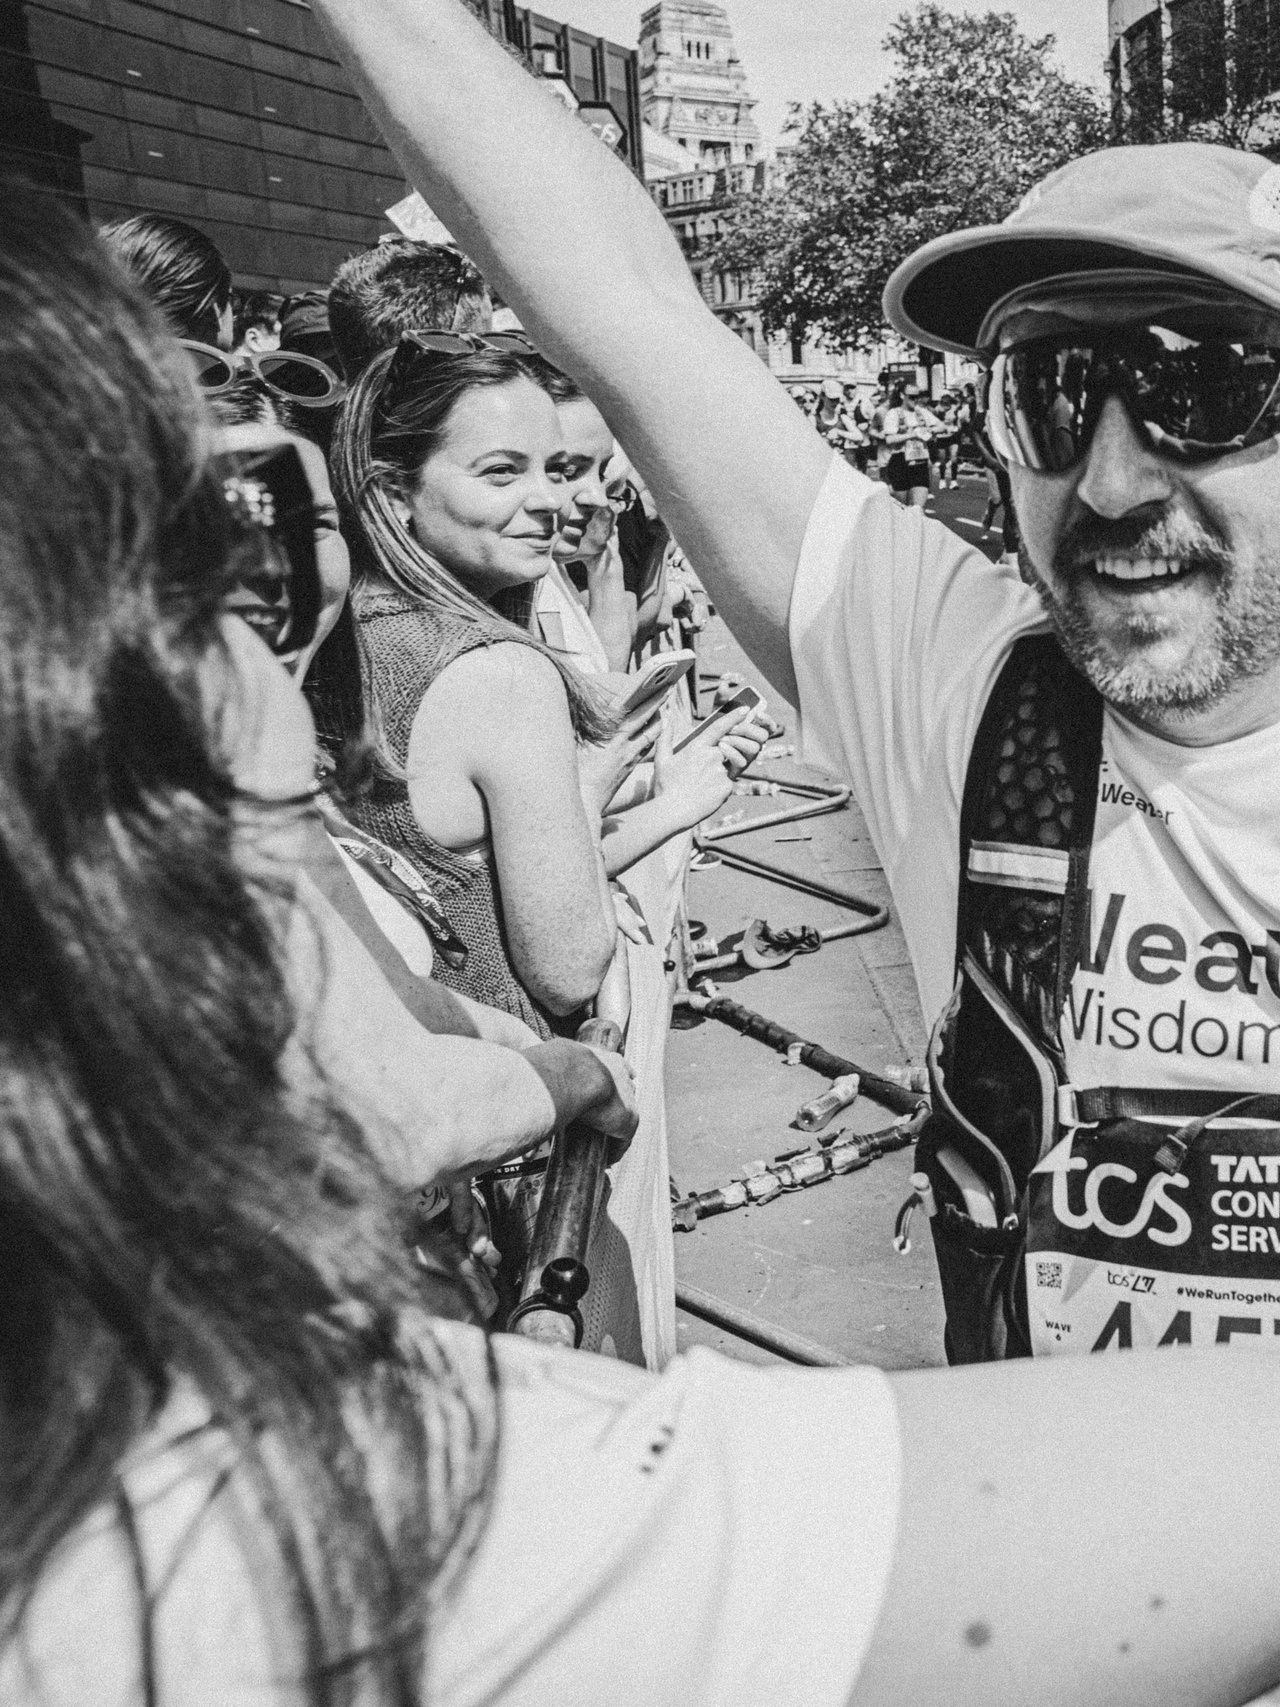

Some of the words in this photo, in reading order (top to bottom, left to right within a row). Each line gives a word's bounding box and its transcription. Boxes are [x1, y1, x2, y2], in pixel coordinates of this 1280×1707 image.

[1052, 1156, 1192, 1247] tcs
[1107, 1270, 1129, 1288] tcs
[1045, 1320, 1072, 1333] WAVE
[1055, 1334, 1062, 1342] 6
